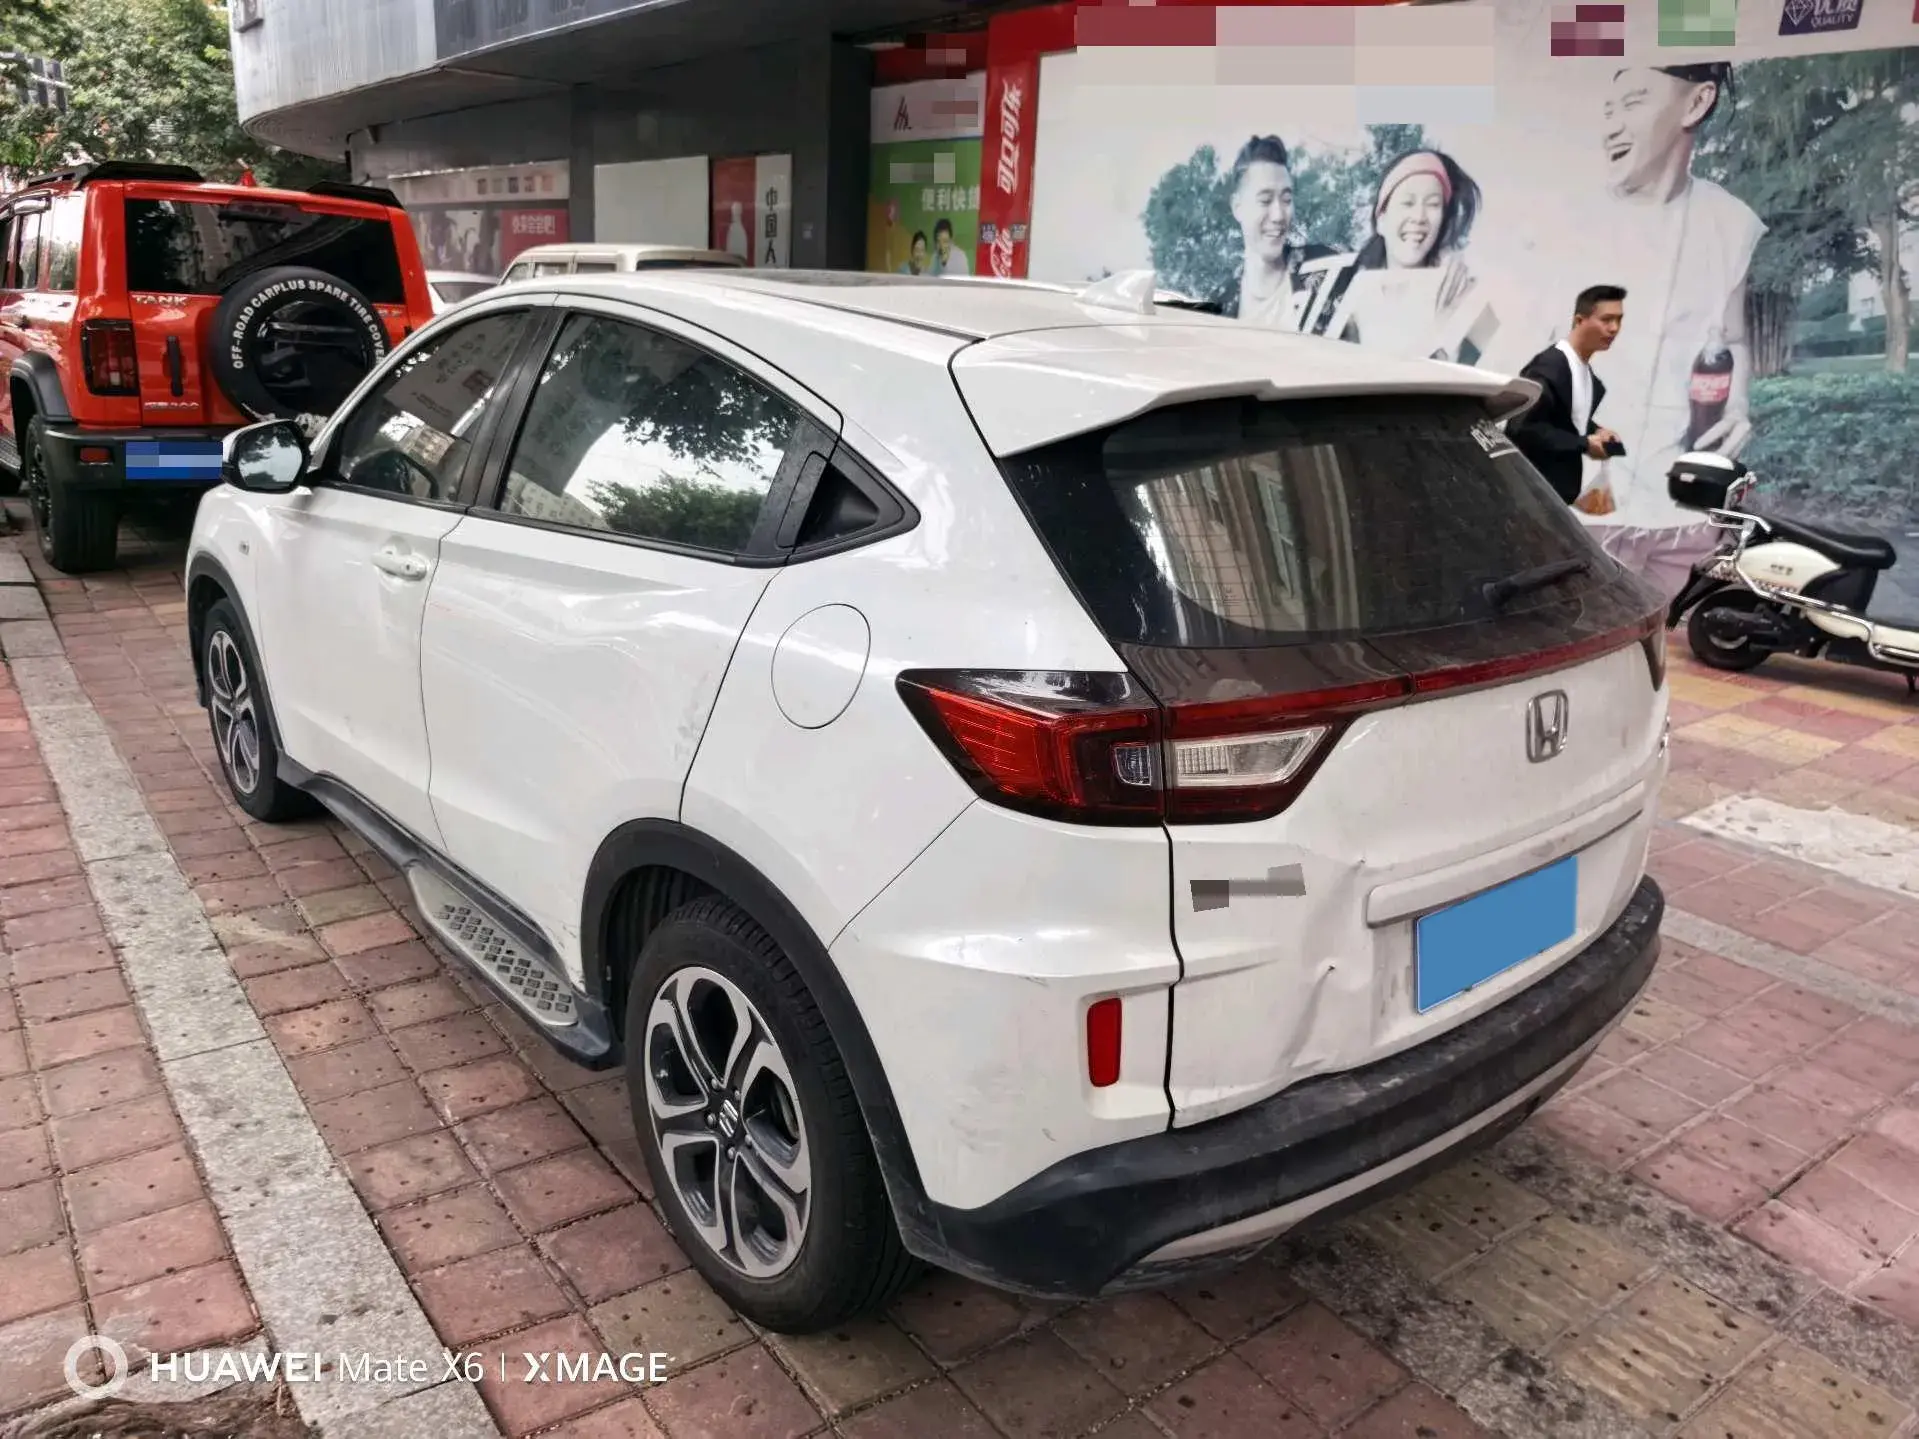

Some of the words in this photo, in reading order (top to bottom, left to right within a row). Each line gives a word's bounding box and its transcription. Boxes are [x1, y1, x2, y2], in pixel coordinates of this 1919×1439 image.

[1811, 13, 1853, 28] QUALITY
[997, 78, 1023, 194] 可口可乐
[764, 186, 779, 264] 中国人
[132, 295, 188, 306] TANK
[231, 306, 255, 369] OFF-ROAD
[250, 279, 306, 308] CARPLUS
[308, 279, 349, 302] SPARE
[349, 297, 374, 324] TIRE
